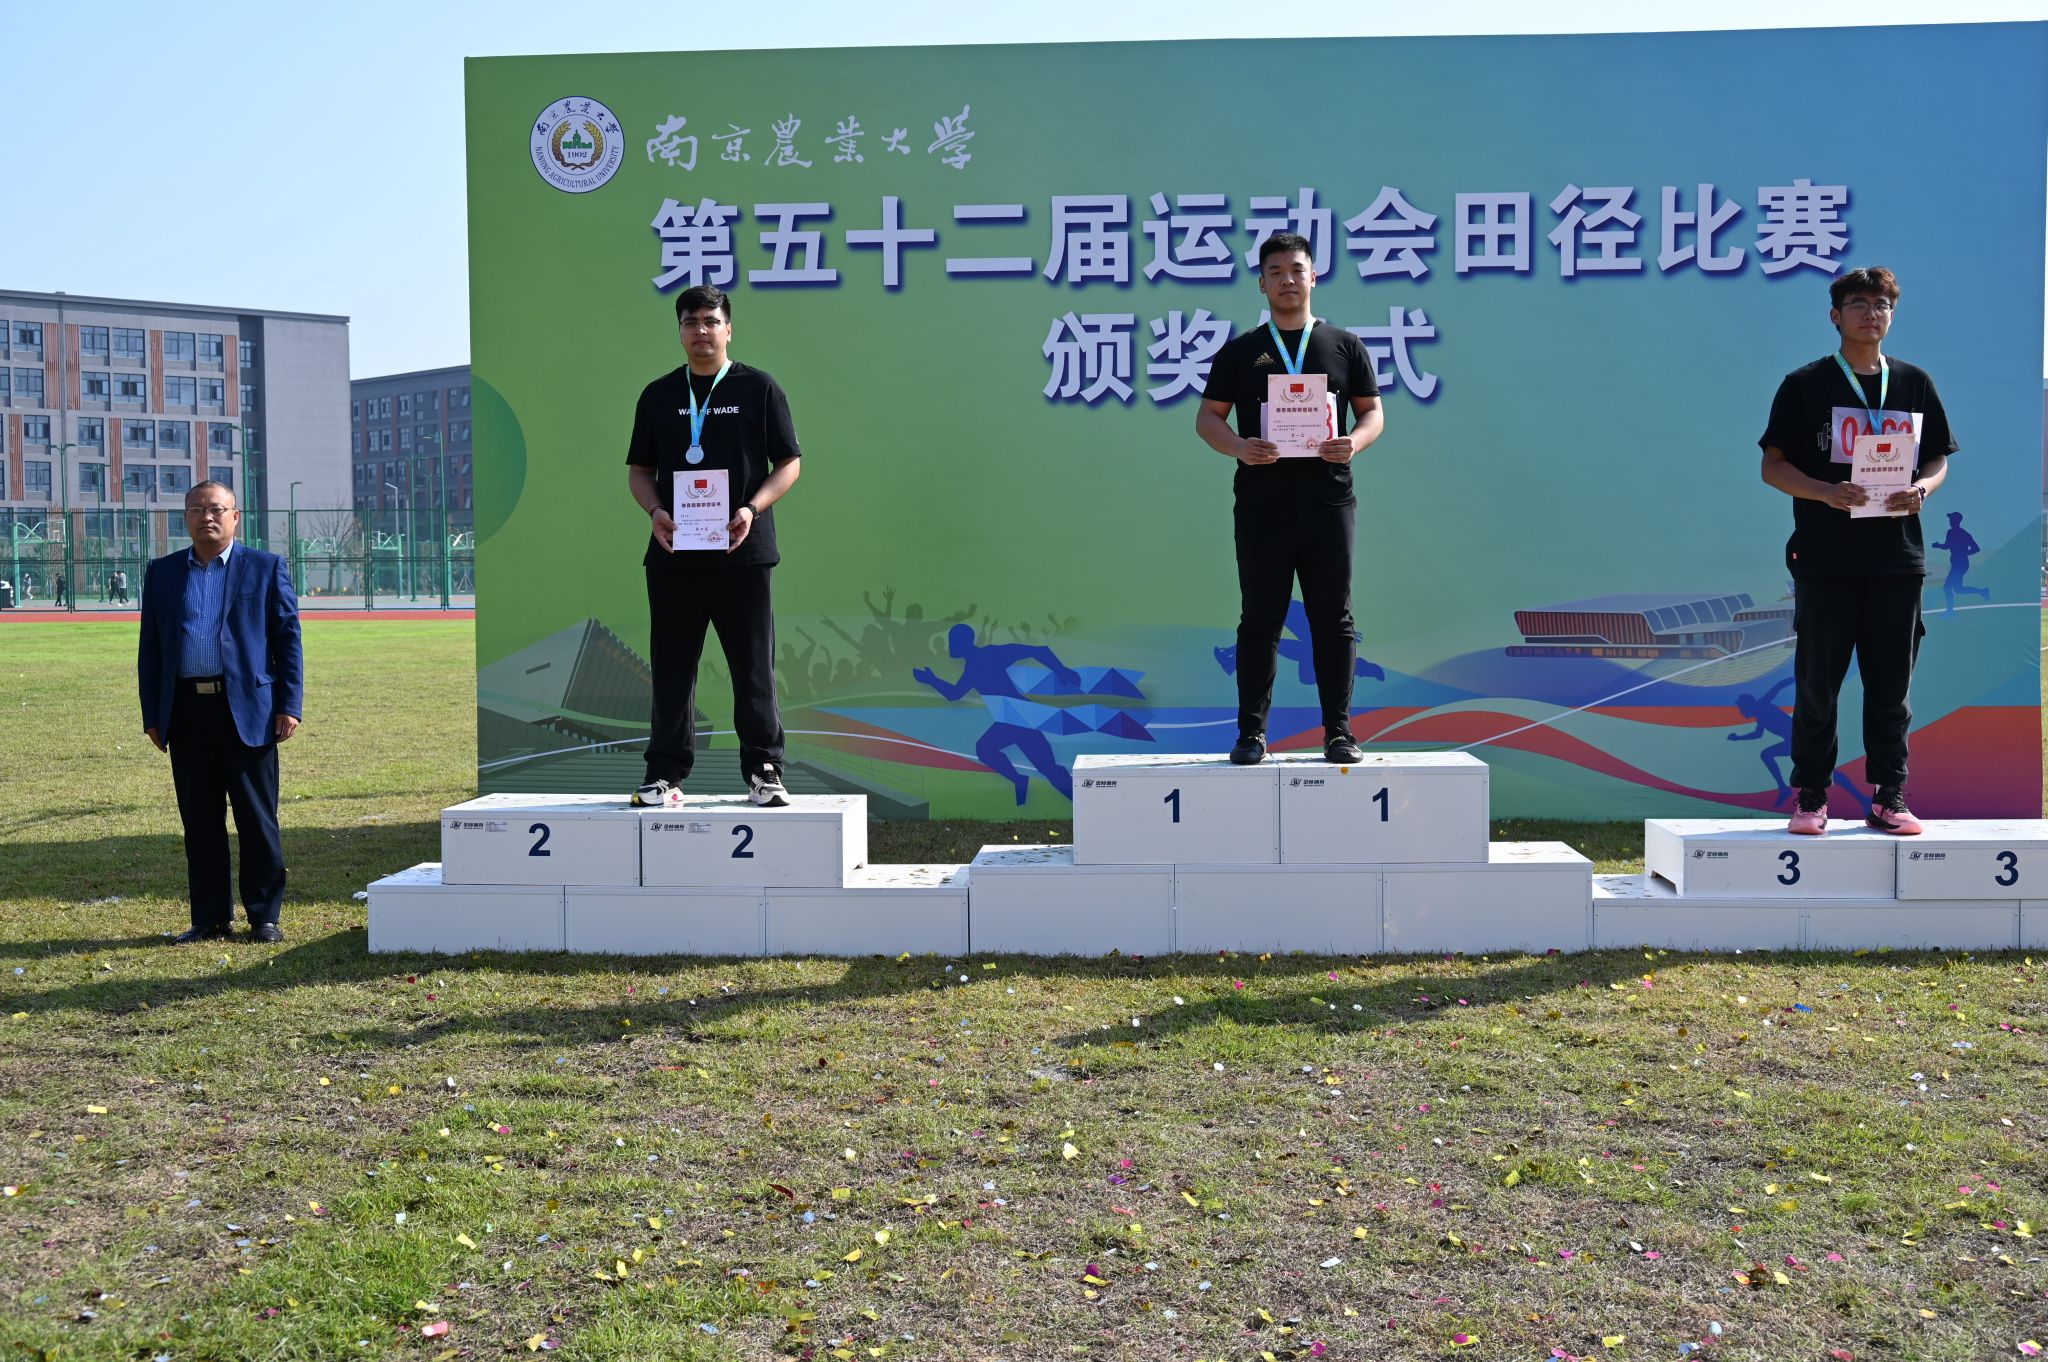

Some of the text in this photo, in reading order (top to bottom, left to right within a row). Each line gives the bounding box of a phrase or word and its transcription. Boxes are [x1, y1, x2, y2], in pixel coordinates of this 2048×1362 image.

[535, 145, 620, 188] NANJING AGRICULTURAL UNIVERSITY
[651, 179, 1849, 289] 第五十二届运动会田径比赛
[1042, 306, 1437, 402] 颁奖式
[713, 406, 740, 415] WADE
[1164, 789, 1180, 823] 1
[1372, 788, 1388, 822] 1
[528, 823, 551, 857] 2
[731, 825, 754, 858] 2
[1777, 850, 1801, 885] 3
[1995, 851, 2019, 886] 3
